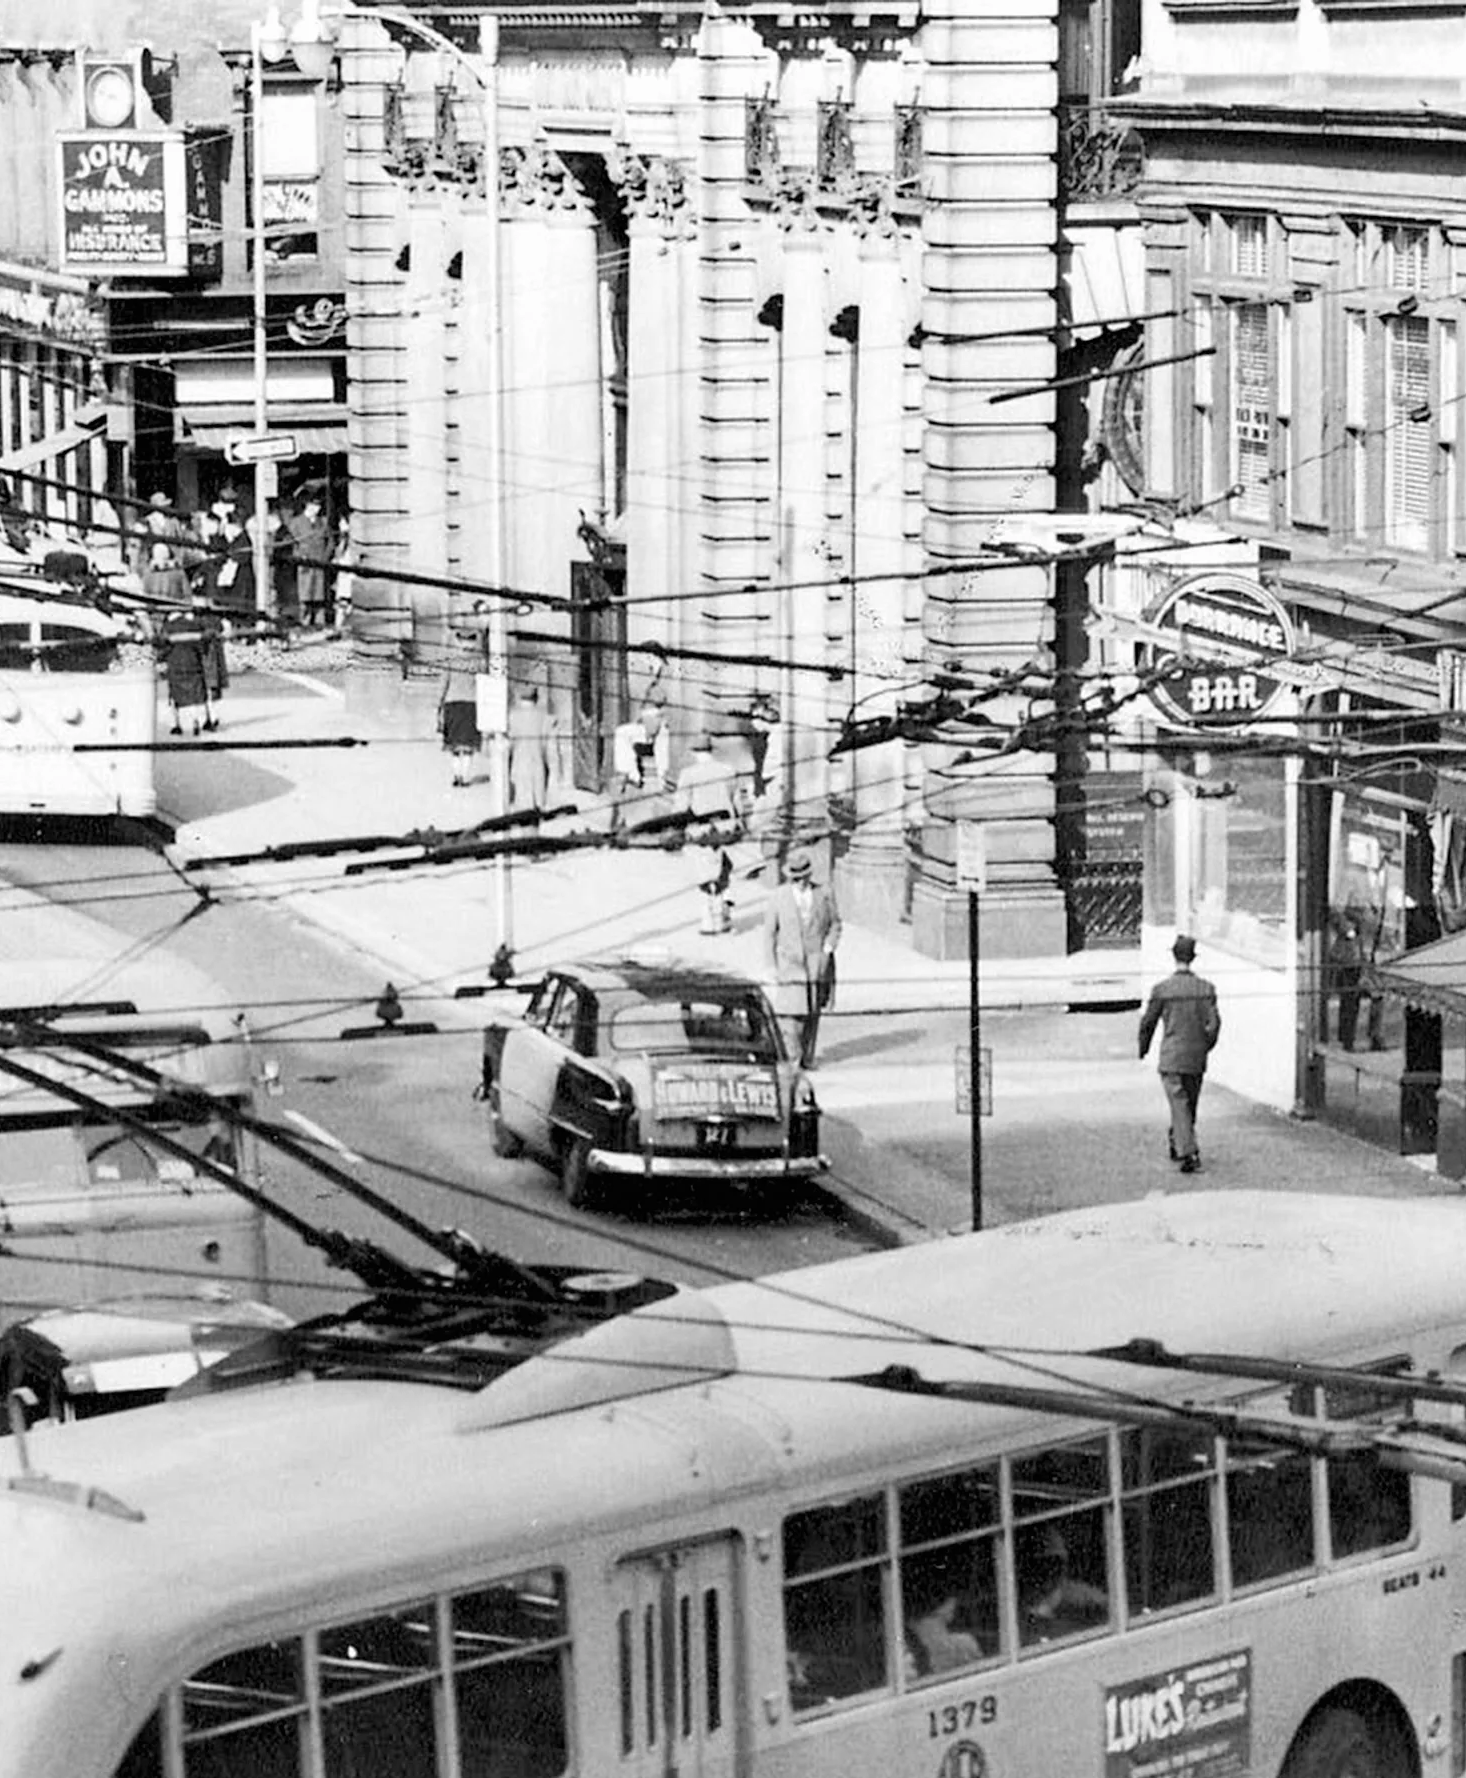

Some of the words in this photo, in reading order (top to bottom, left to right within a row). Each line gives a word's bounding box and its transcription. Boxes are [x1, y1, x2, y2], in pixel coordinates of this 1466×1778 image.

[76, 142, 149, 178] JOHN
[64, 188, 164, 213] GAMMONS
[68, 232, 162, 251] INSURANCE
[1189, 674, 1264, 713] BAR
[930, 1695, 998, 1738] 1379
[1106, 1673, 1185, 1753] LUKE'S
